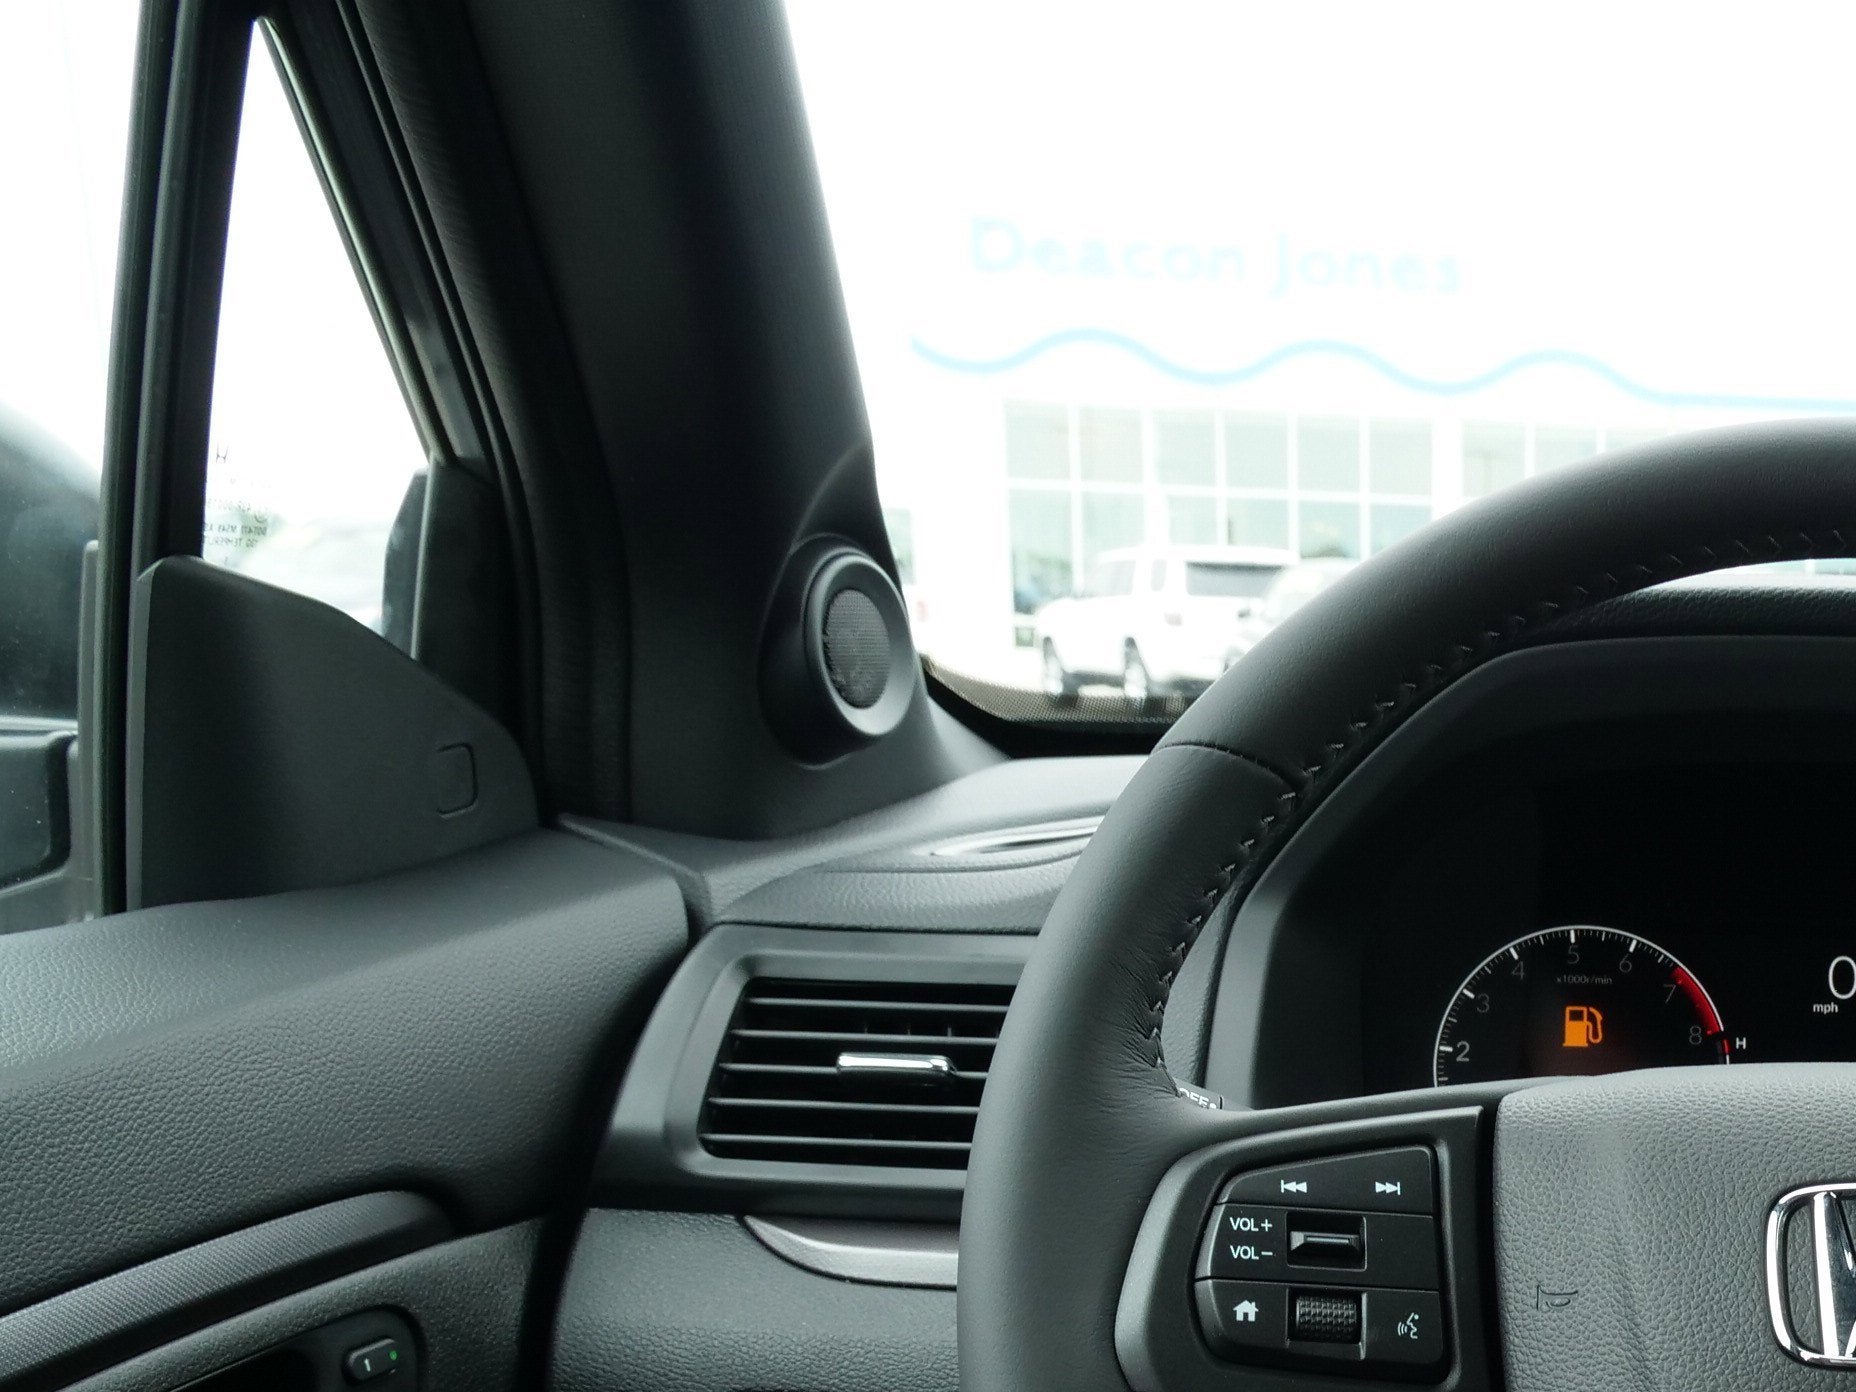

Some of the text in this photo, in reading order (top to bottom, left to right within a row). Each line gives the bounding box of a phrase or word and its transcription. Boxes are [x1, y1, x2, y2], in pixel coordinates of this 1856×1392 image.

[970, 214, 1463, 298] Deacon Jones
[1568, 944, 1580, 964] 5
[1619, 952, 1632, 973] 6
[1511, 961, 1525, 980] 4
[1476, 993, 1490, 1013] 3
[1663, 984, 1677, 1003] 7
[1812, 1003, 1839, 1015] mph
[1689, 1025, 1702, 1045] 8
[1735, 1037, 1747, 1050] H
[1456, 1041, 1470, 1062] 2
[363, 1358, 372, 1372] 1
